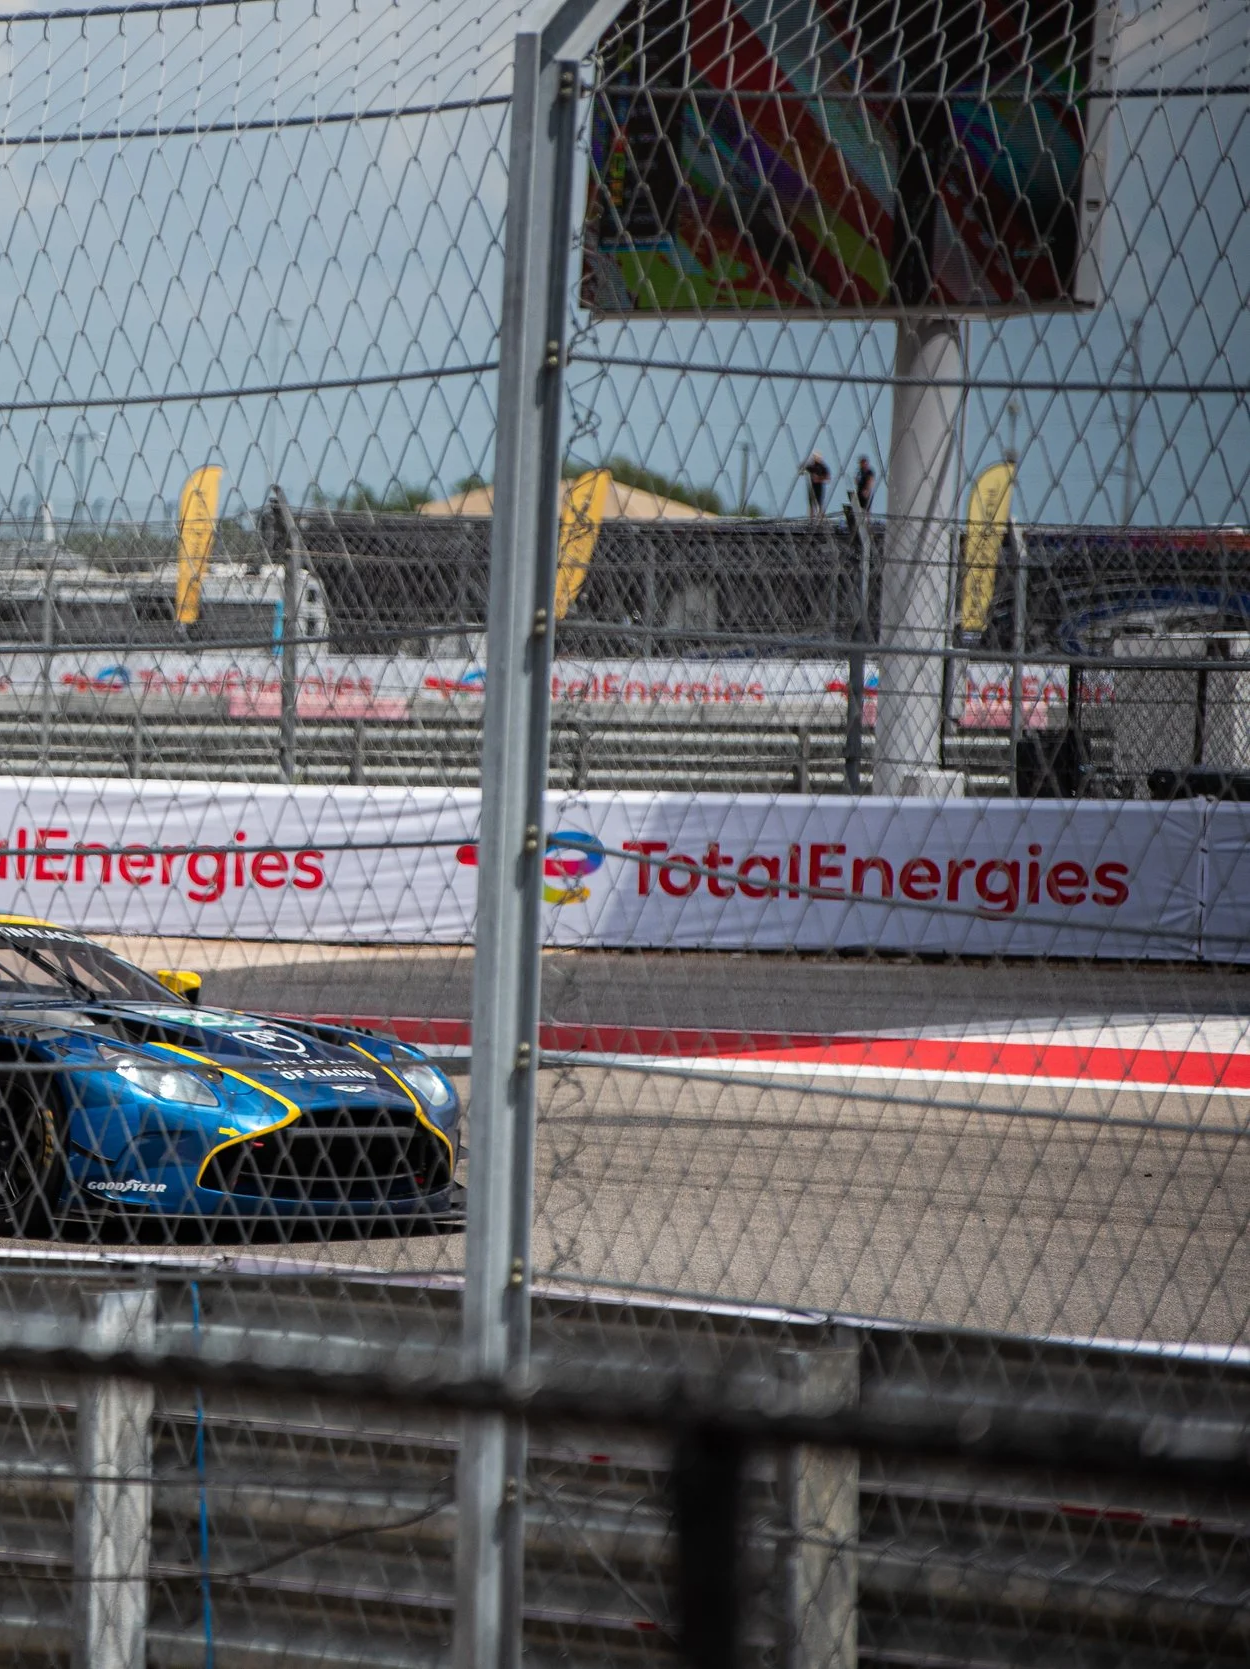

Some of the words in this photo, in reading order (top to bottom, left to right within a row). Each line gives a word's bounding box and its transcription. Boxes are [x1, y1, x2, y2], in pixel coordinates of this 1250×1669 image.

[622, 841, 1129, 921] TotalEnergies
[280, 1069, 307, 1080] OF
[308, 1068, 377, 1079] RACING
[87, 1179, 167, 1193] GOODYEAR
